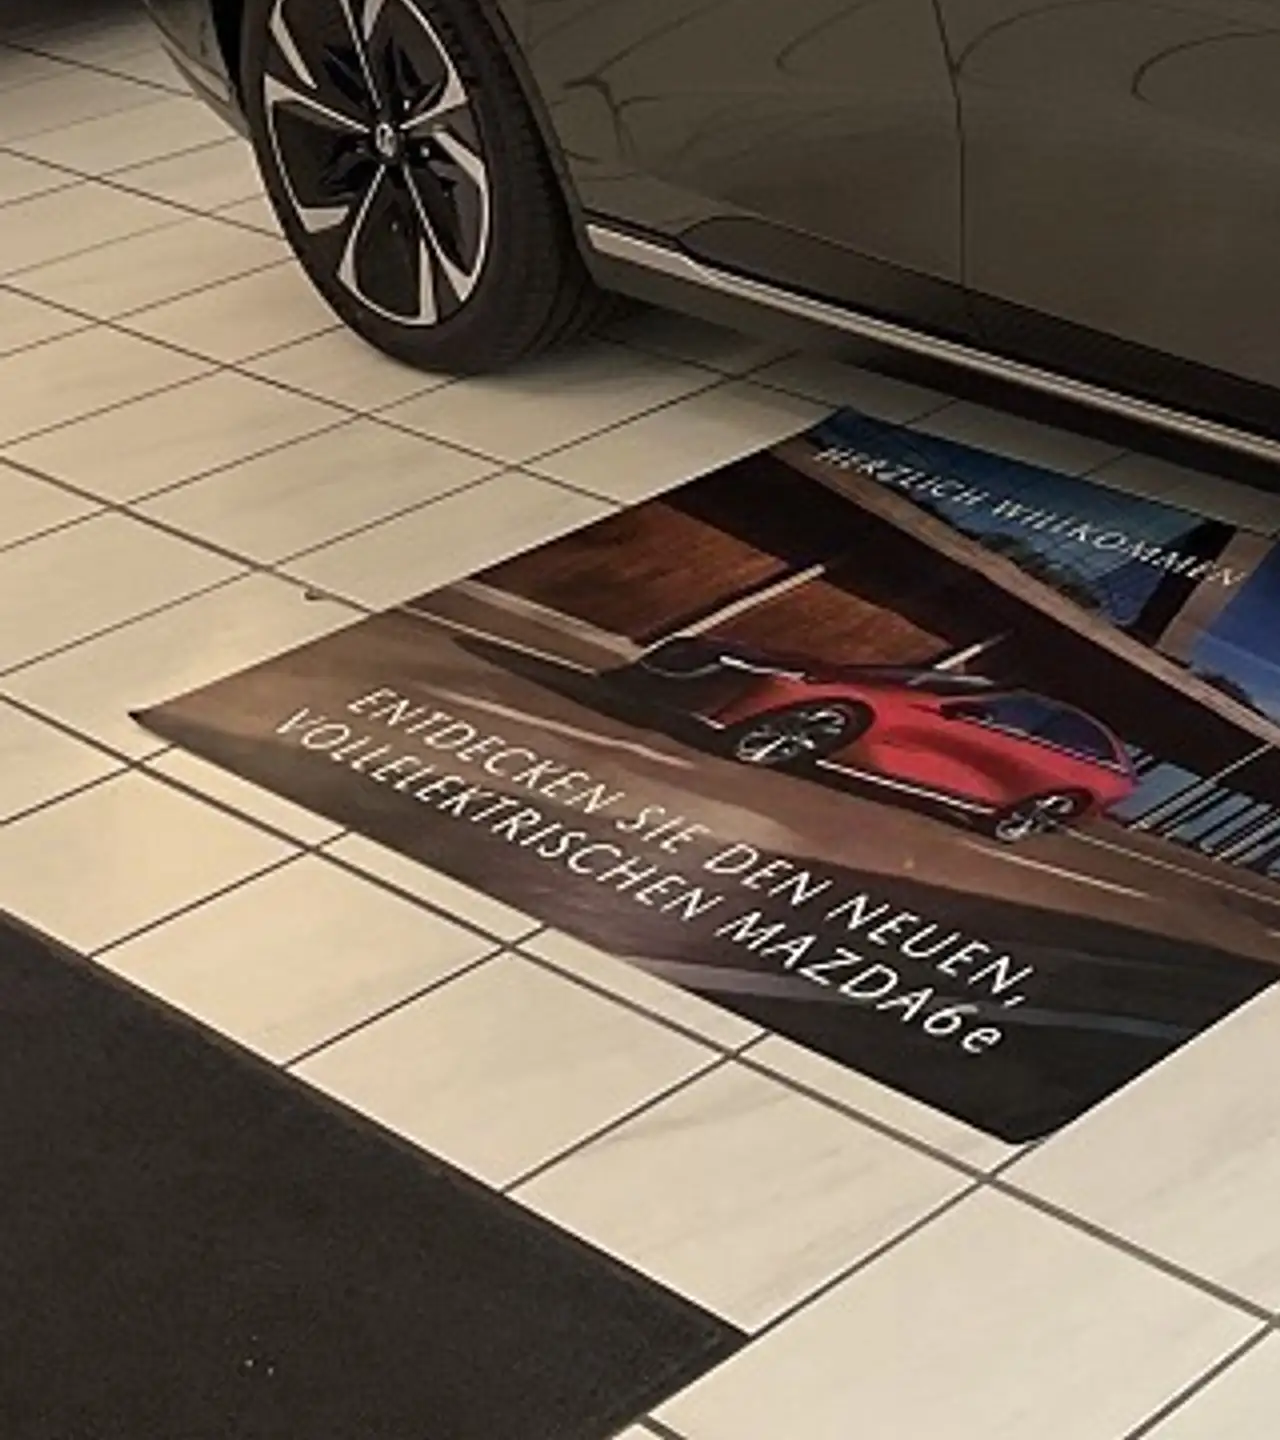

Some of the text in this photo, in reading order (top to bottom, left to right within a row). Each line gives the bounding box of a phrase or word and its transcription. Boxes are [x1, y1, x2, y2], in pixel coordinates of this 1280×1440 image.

[814, 444, 1247, 587] HERZLICH WILLKOMMEN
[275, 707, 1003, 1055] VOLLELEKTRISCHEN MAZDA6e
[347, 686, 1035, 1009] ENTDECKEN SIE DEN NEUEN,
